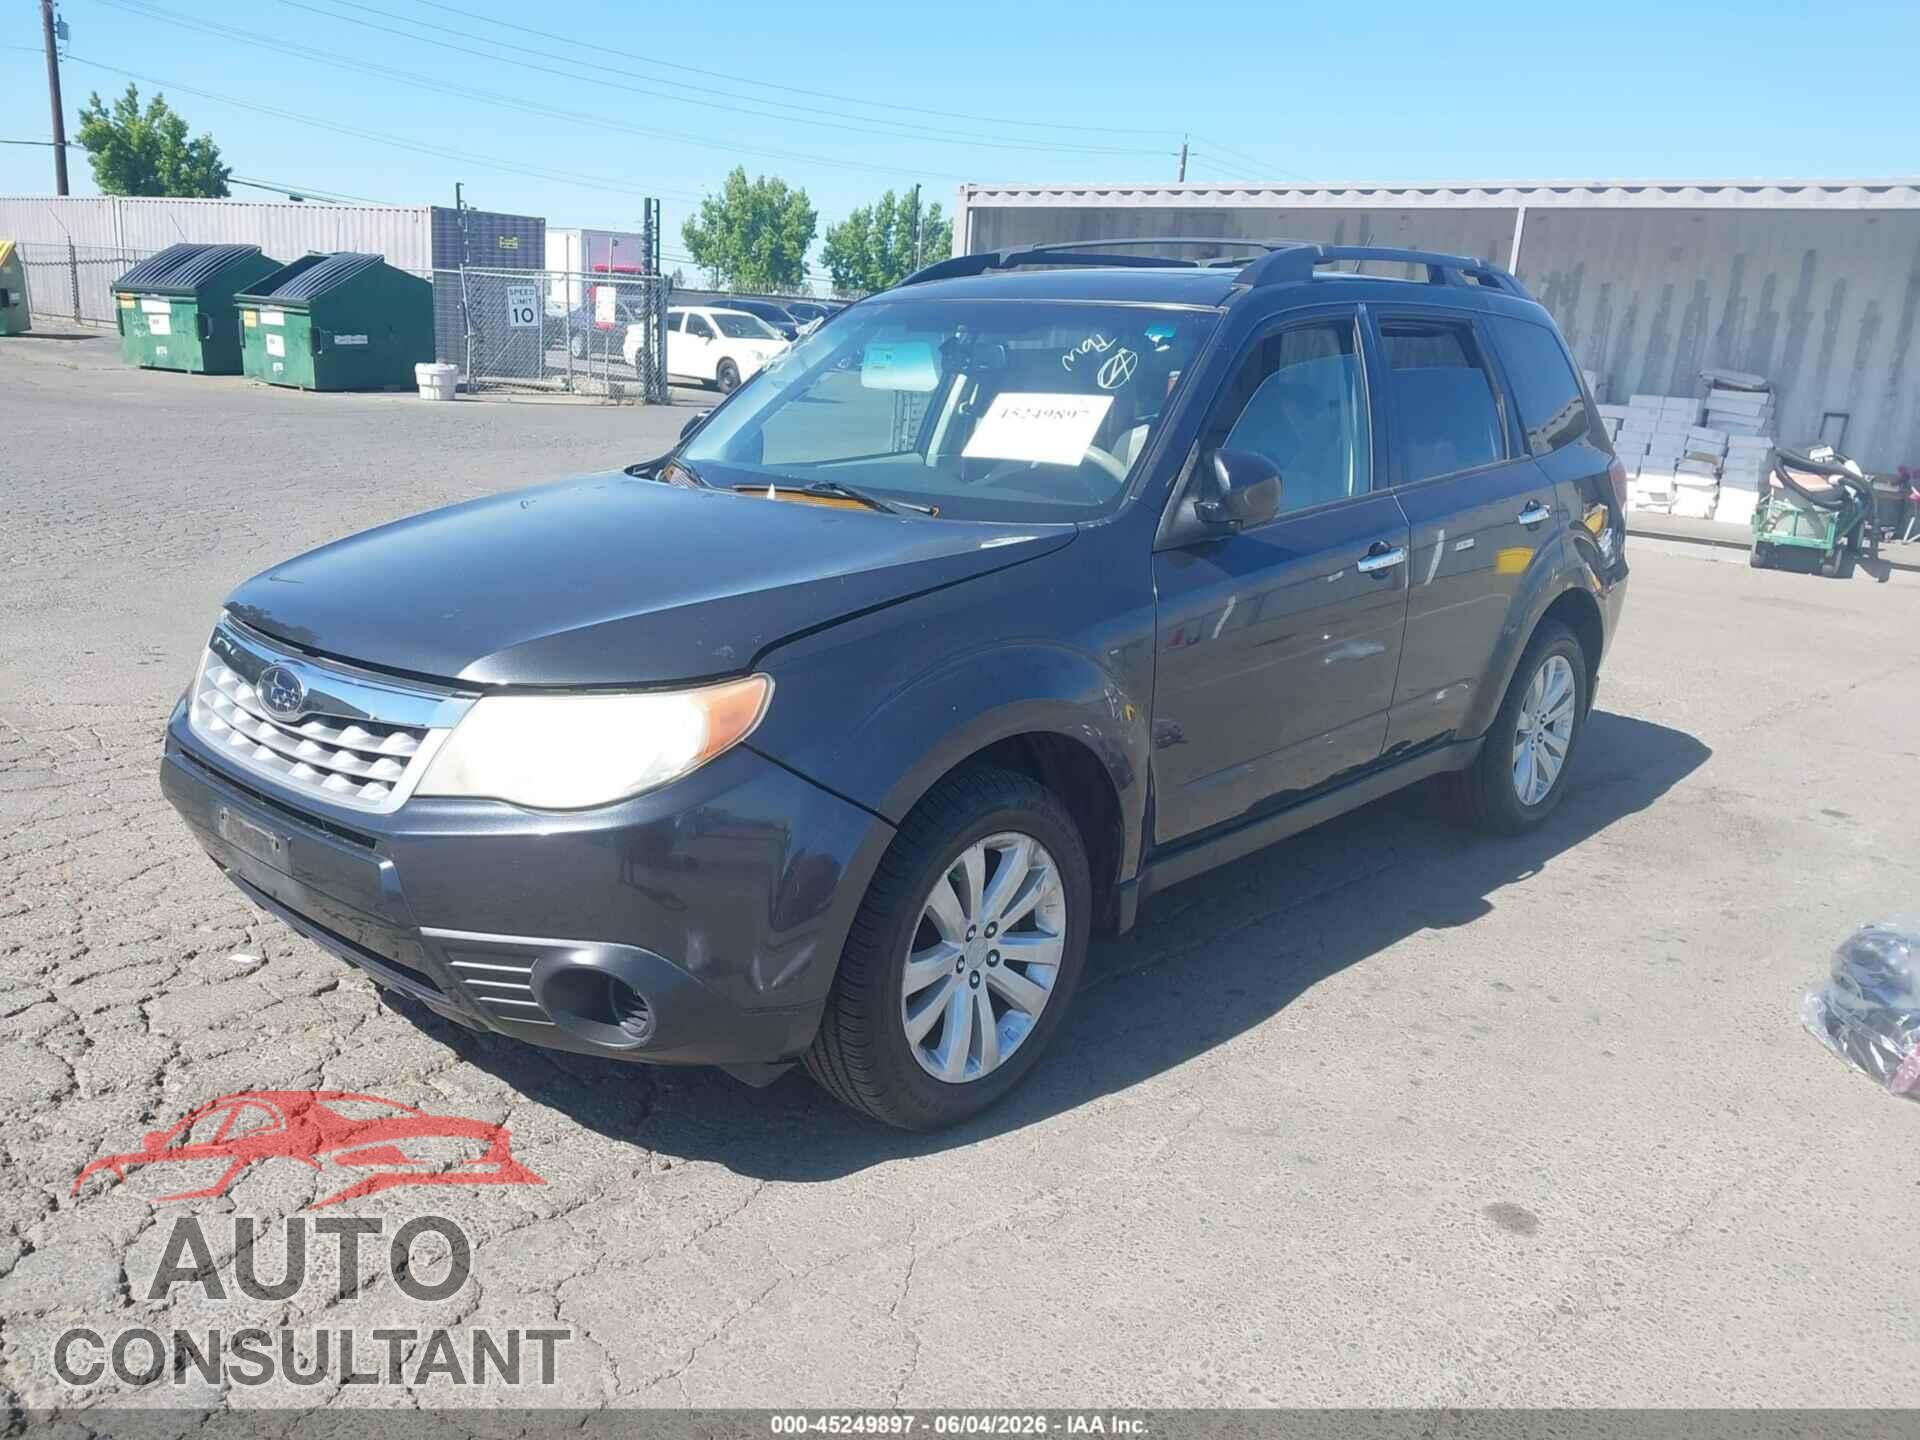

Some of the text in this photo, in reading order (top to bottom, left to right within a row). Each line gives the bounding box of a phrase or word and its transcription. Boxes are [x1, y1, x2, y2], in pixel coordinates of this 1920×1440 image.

[508, 288, 535, 296] SPEED
[511, 297, 532, 305] LIMIT
[513, 307, 534, 323] 10
